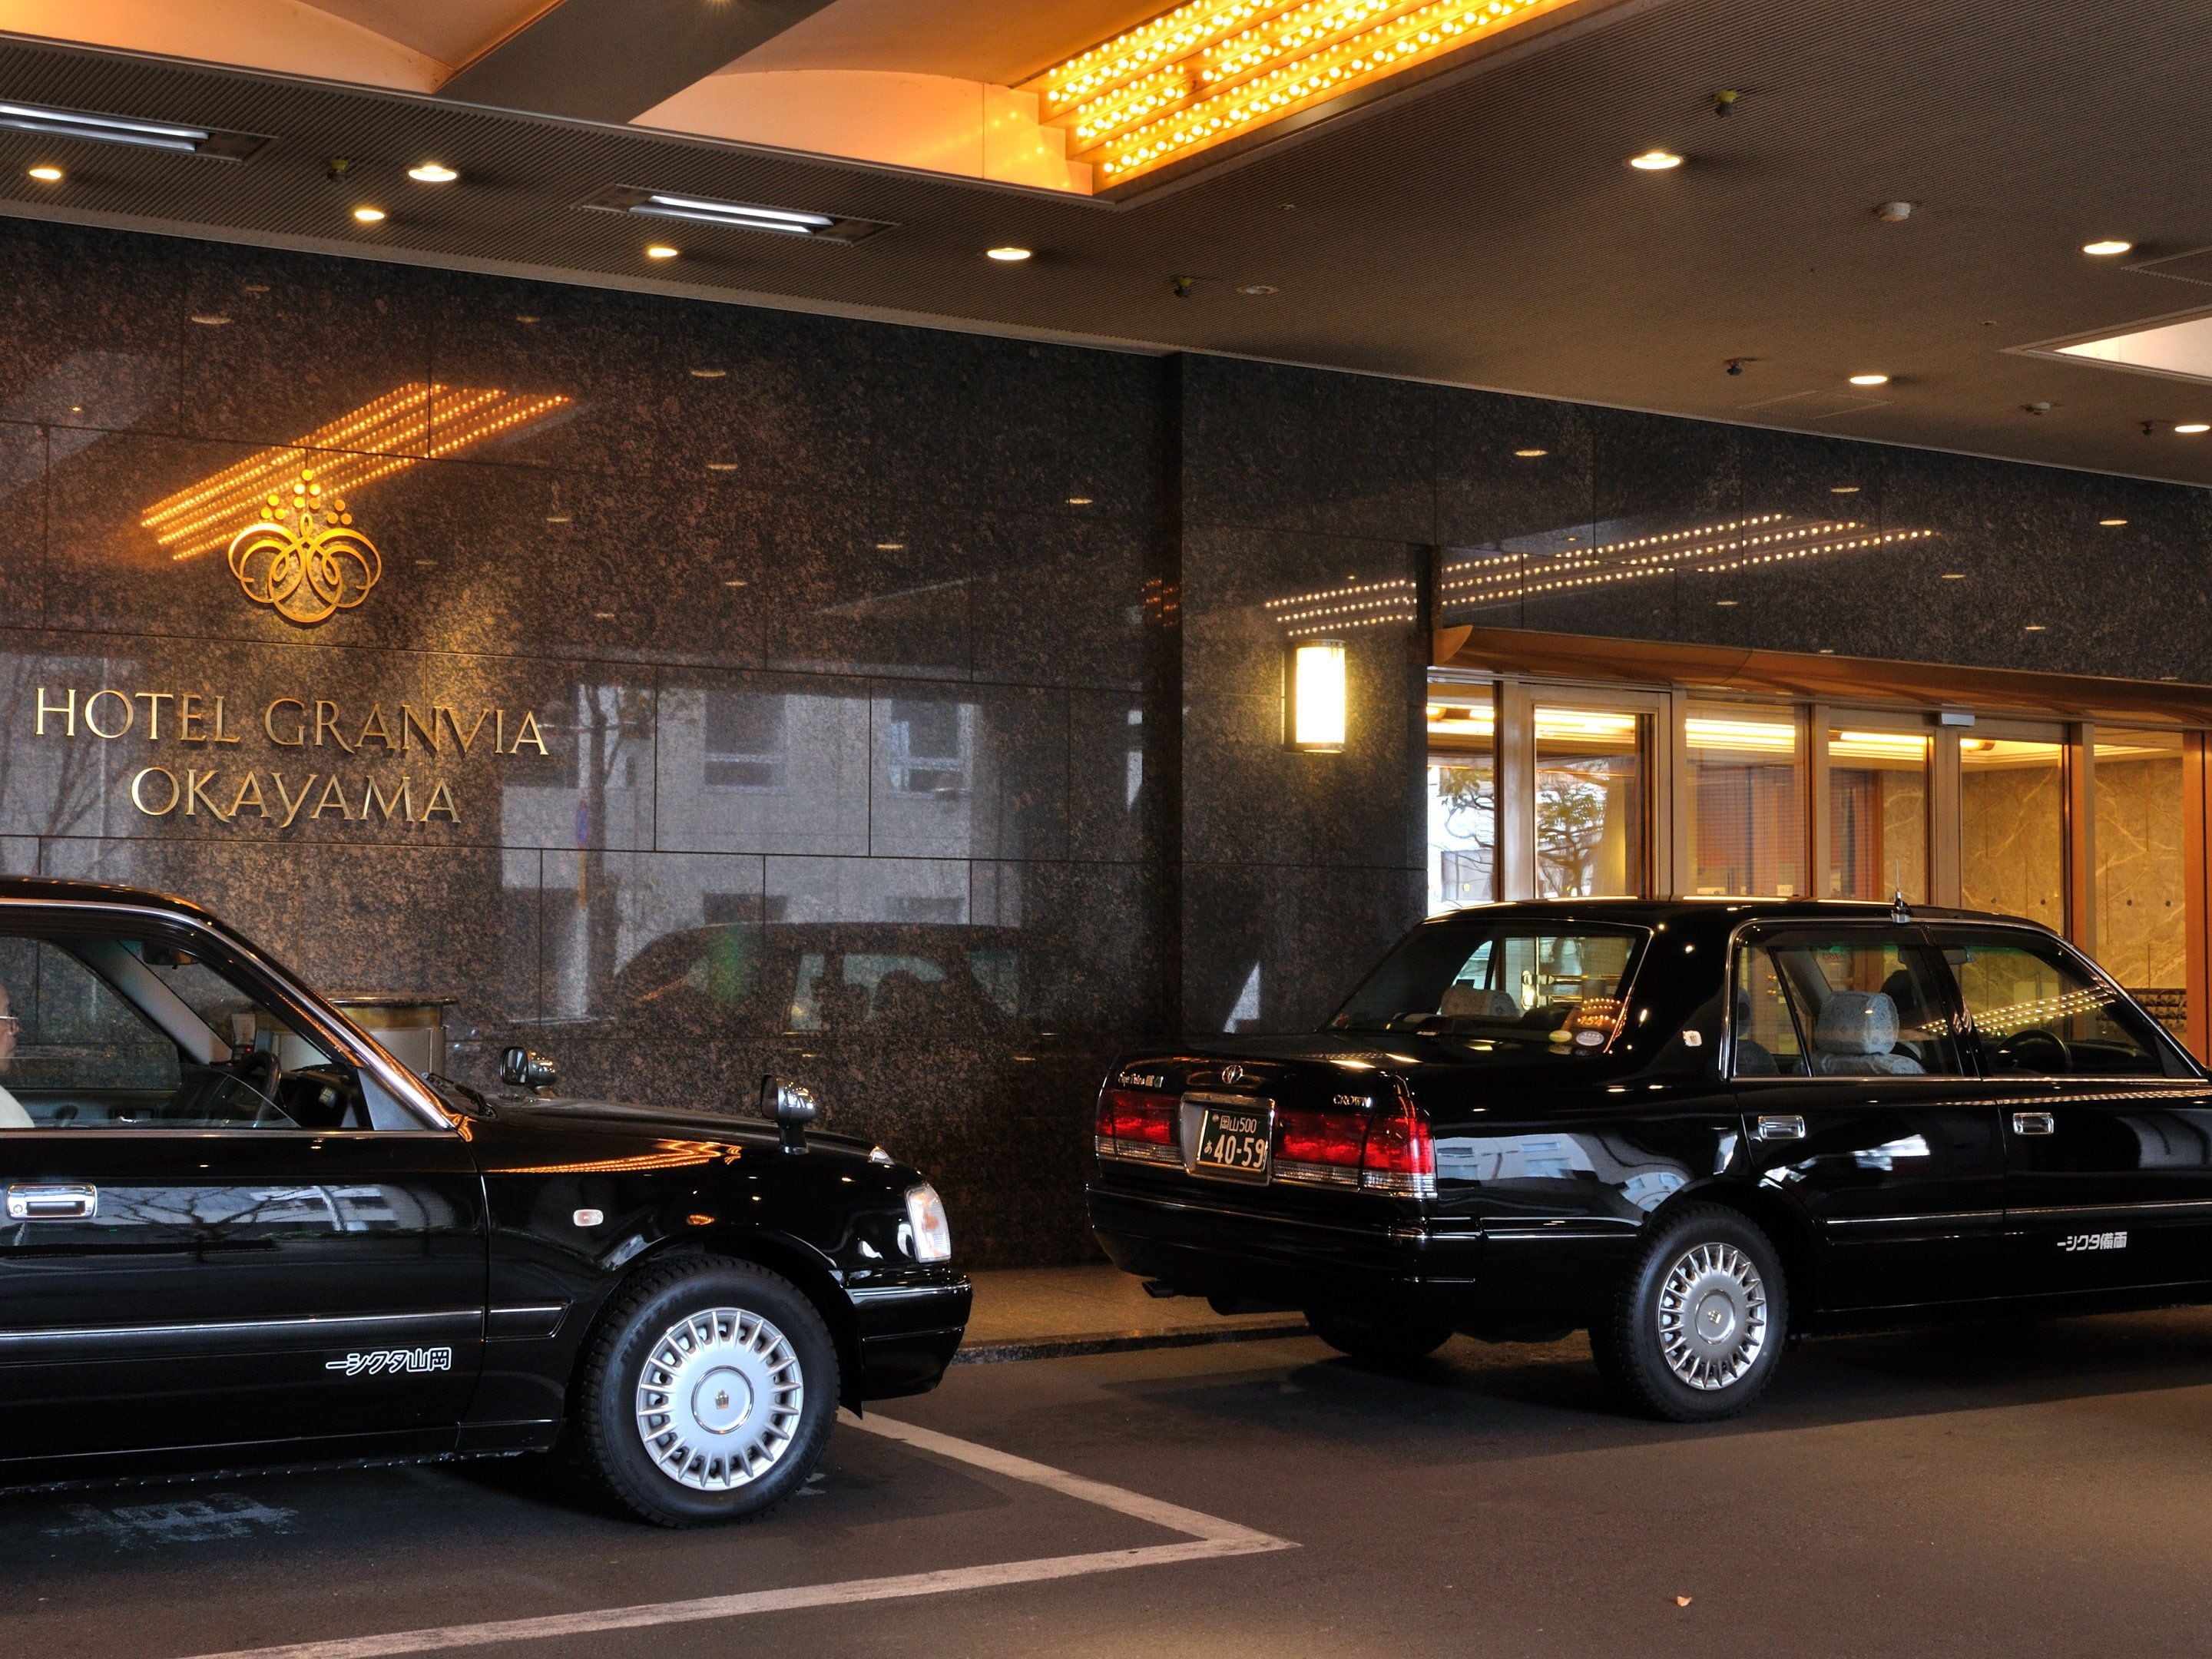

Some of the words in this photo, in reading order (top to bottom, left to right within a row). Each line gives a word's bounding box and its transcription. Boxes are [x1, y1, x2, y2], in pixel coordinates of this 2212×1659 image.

[36, 688, 240, 743] HOTEL
[266, 698, 549, 756] GRANVIA
[131, 767, 461, 828] OKAYAMA
[1333, 1094, 1373, 1108] CROWN
[1214, 1134, 1265, 1167] 40-59
